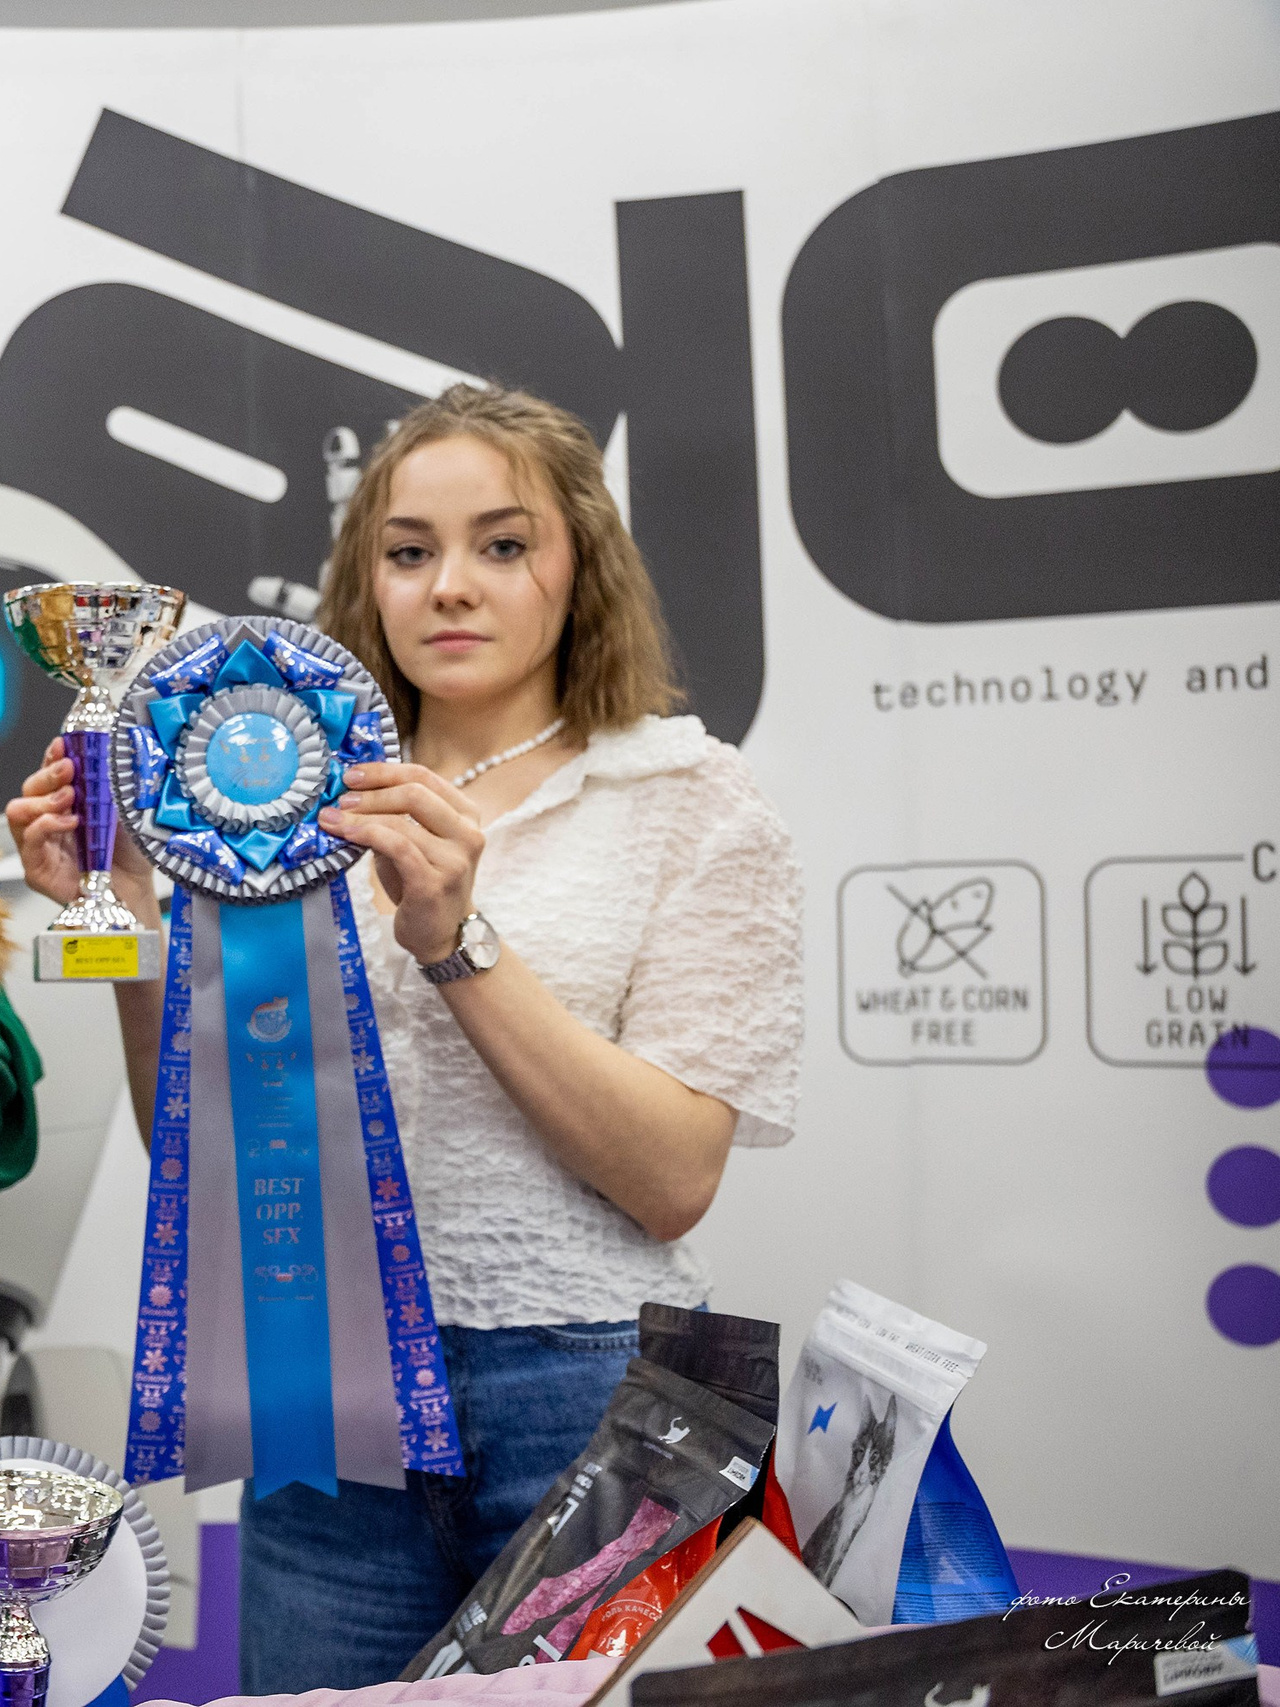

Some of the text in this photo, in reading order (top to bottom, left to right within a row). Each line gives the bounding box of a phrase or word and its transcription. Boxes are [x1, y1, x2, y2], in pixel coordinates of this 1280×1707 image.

[873, 655, 1269, 713] technology and
[855, 984, 1030, 1015] WHEAT & CORN
[1165, 986, 1228, 1015] LOW
[910, 1019, 976, 1046] FREE
[1145, 1018, 1250, 1050] GRAIN
[254, 1178, 304, 1196] BEST
